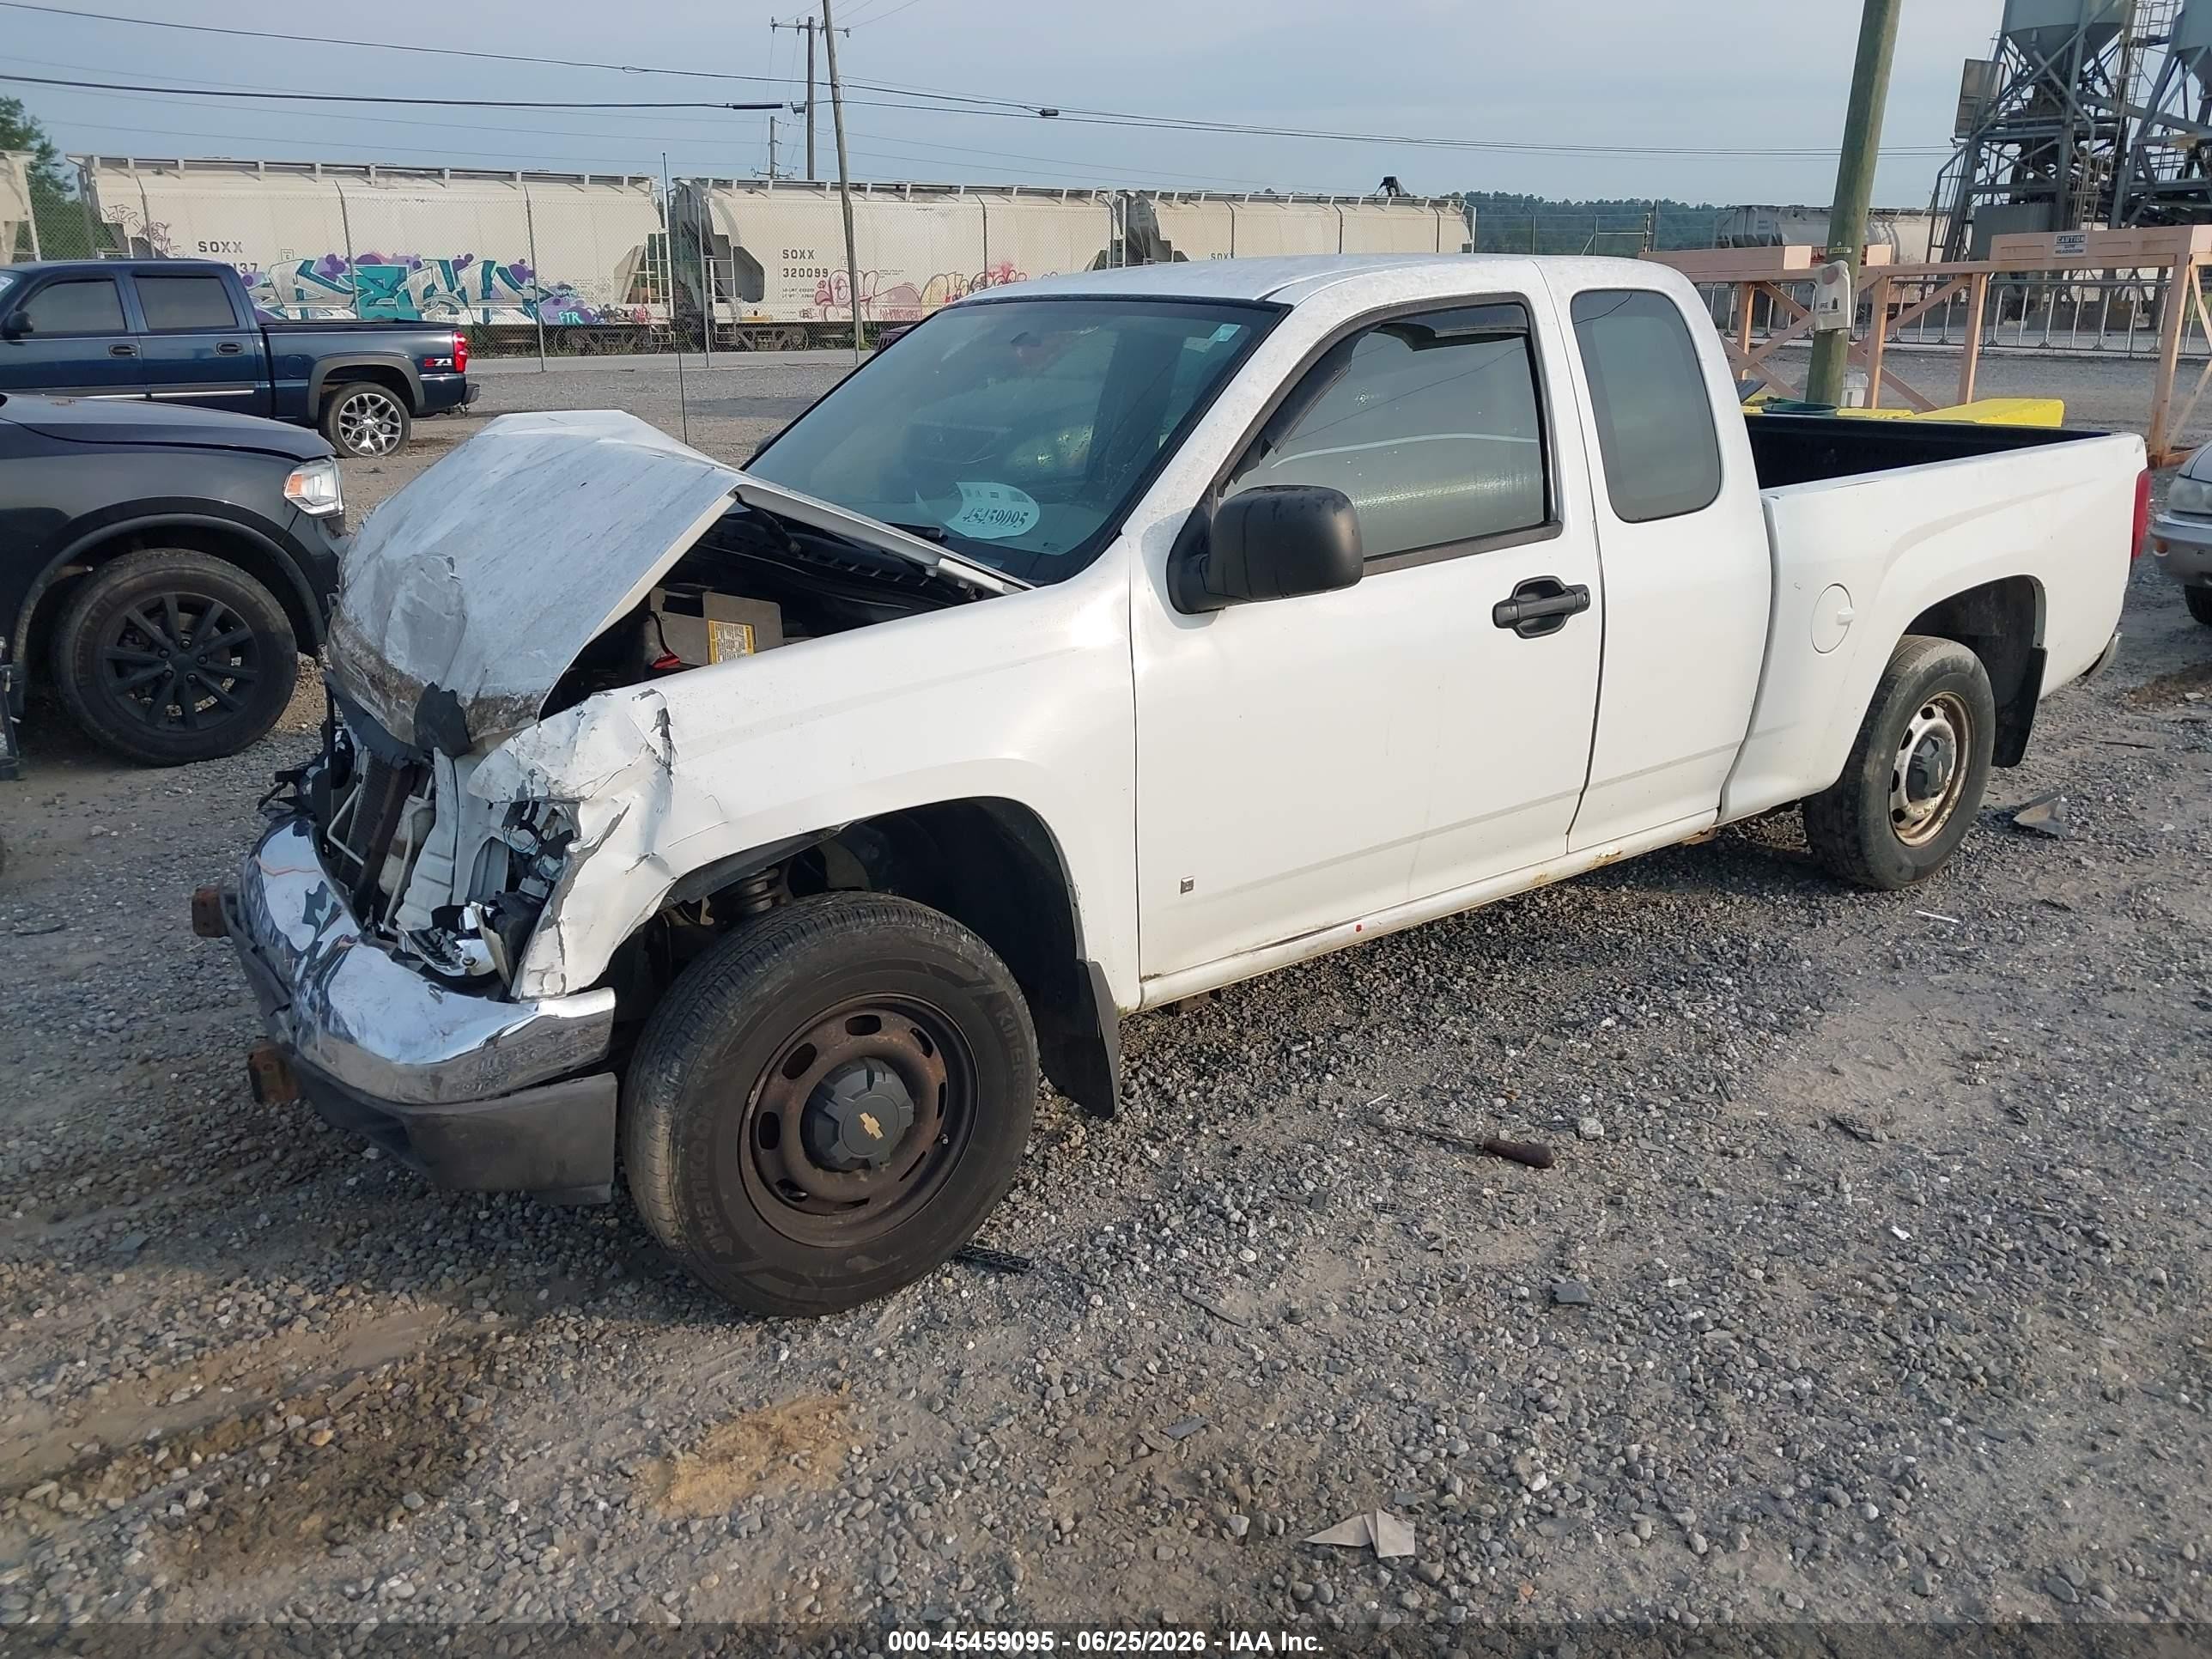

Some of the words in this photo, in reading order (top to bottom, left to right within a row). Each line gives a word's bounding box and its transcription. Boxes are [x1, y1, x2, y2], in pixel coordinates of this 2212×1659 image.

[198, 240, 243, 253] SOXX
[782, 249, 816, 259] SOXX
[227, 262, 258, 274] 137
[782, 268, 829, 278] 320099
[558, 311, 585, 325] FTR
[961, 507, 1030, 528] 45459095
